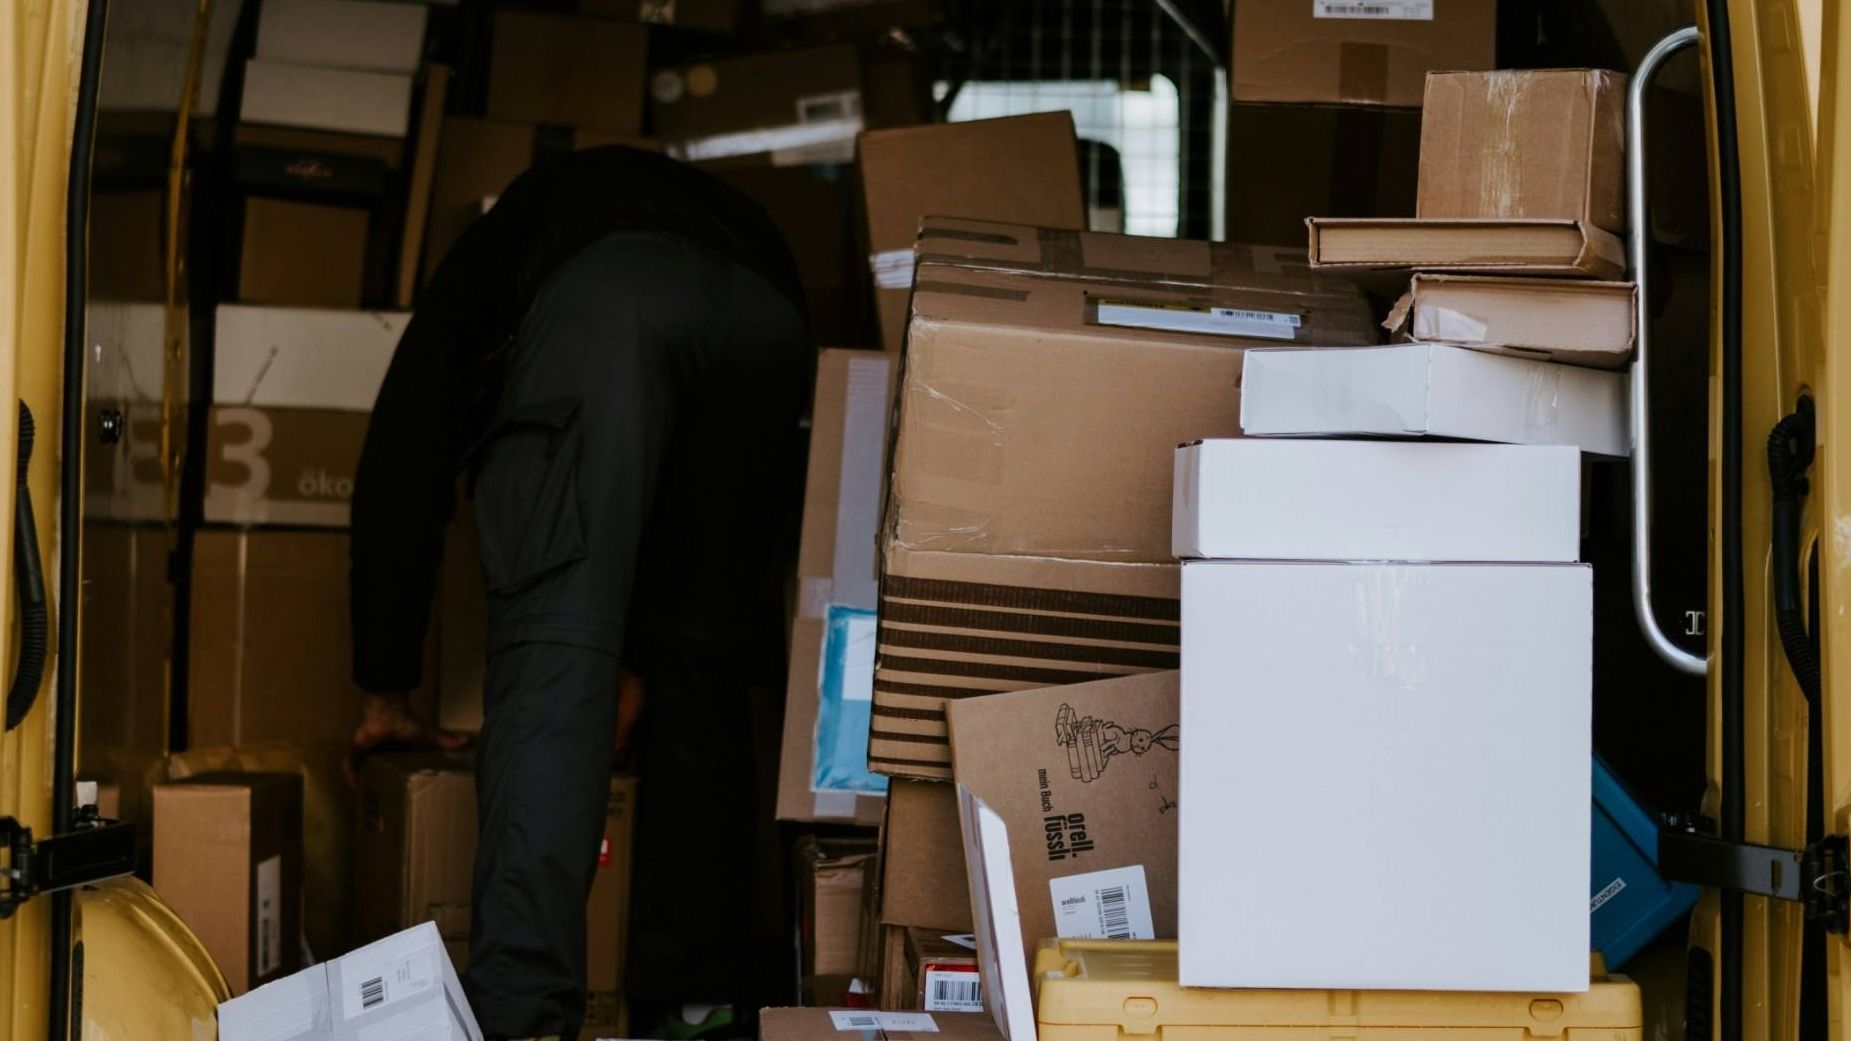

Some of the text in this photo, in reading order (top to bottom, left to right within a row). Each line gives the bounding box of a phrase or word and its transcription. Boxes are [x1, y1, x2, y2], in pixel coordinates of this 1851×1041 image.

[1038, 768, 1053, 812] mein Buch
[1044, 815, 1070, 860] füssli
